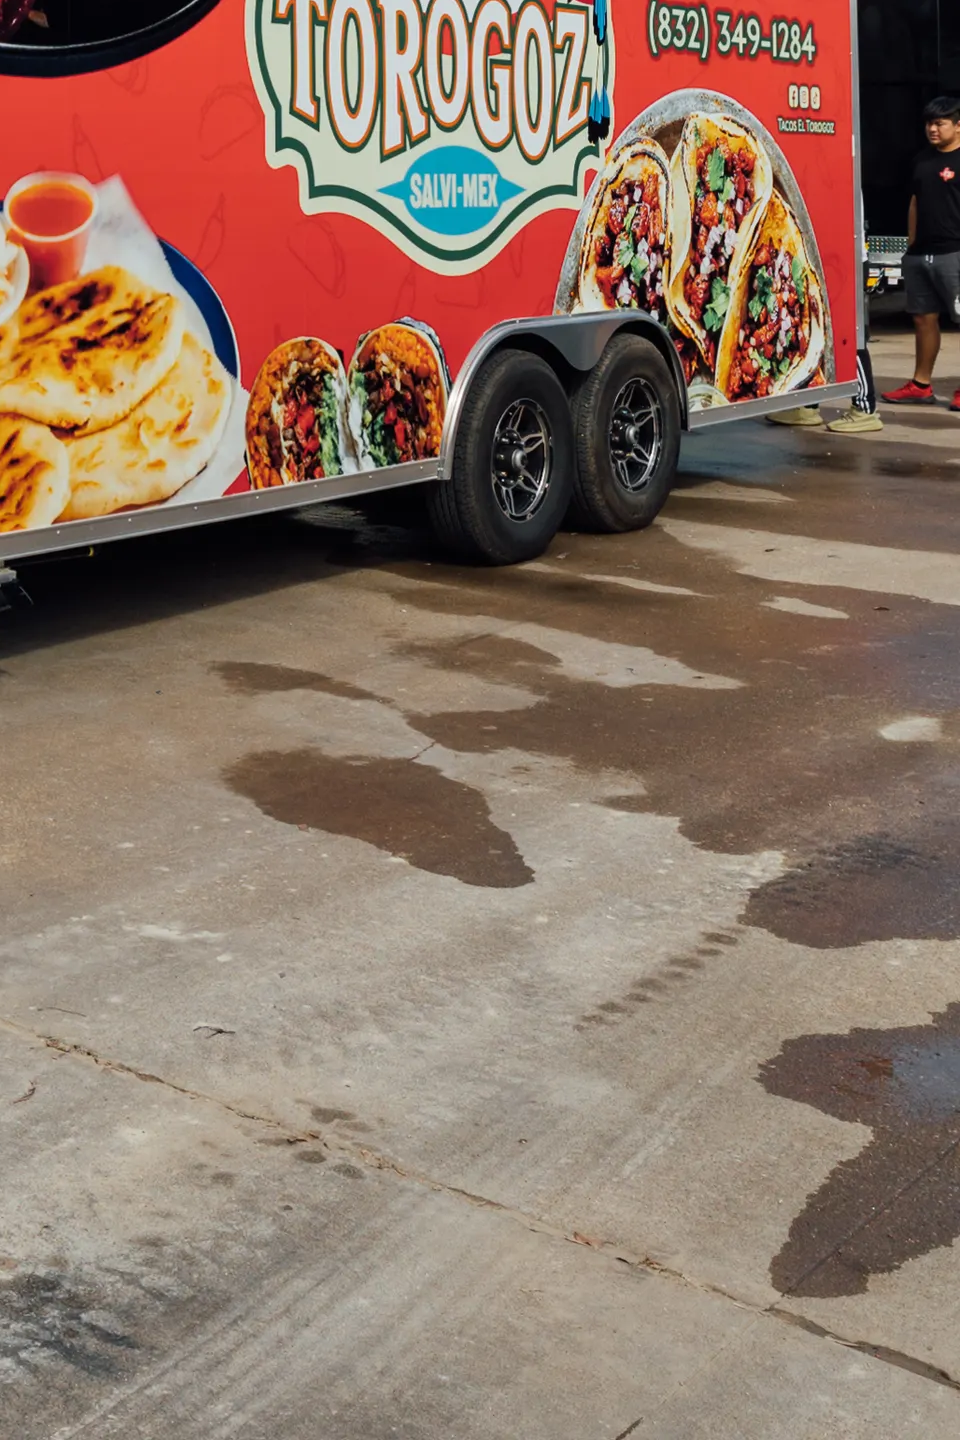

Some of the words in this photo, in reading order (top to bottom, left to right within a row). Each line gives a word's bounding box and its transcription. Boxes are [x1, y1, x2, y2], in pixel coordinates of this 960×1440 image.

[649, 0, 710, 59] (832)
[716, 13, 816, 61] 349-1284
[409, 172, 499, 209] SALVI-MEX
